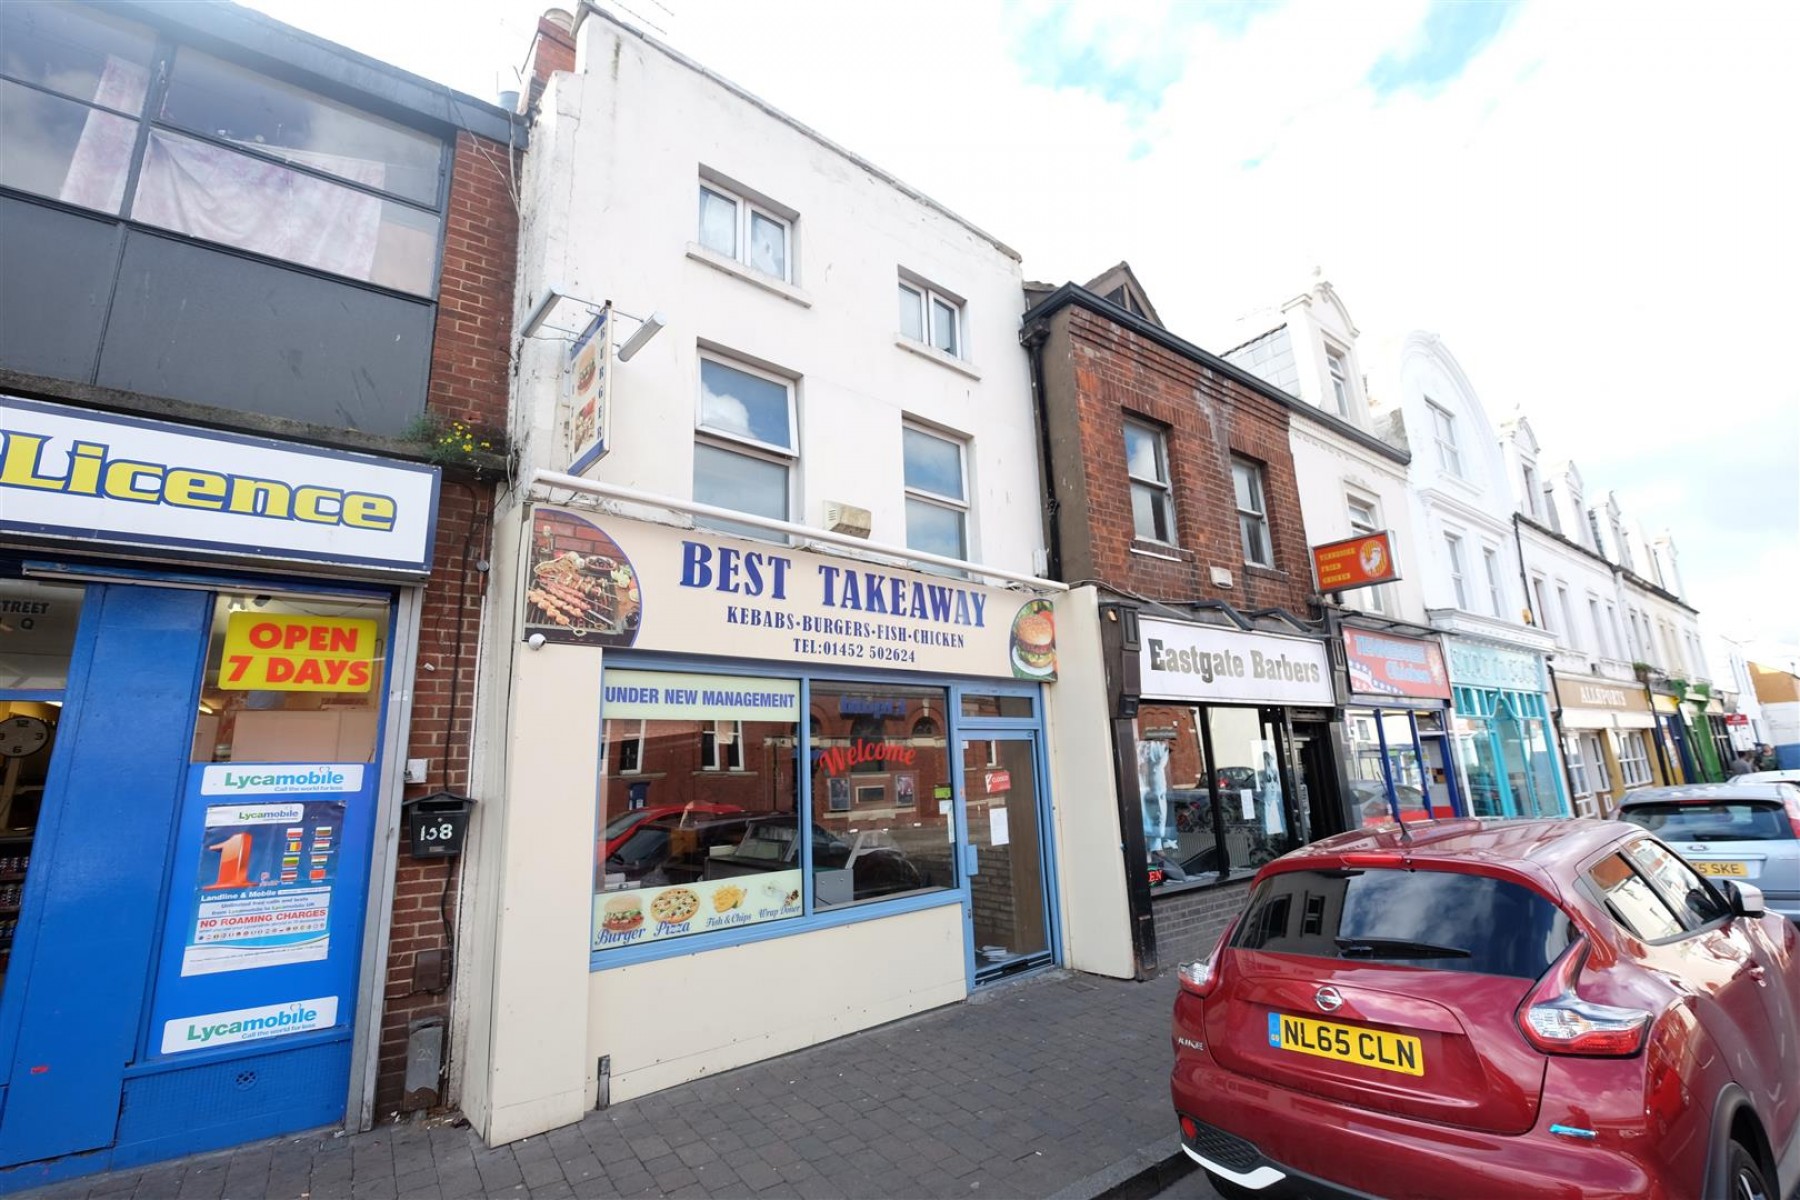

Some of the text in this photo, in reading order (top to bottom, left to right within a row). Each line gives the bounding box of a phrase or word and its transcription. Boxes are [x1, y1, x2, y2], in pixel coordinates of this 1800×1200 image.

[0, 430, 397, 532] Licence
[680, 540, 987, 628] BEST TAKEAWAY
[0, 600, 49, 614] TREET
[249, 622, 358, 652] OPEN
[793, 638, 915, 662] TEL:01452 502624
[1148, 638, 1320, 683] Eastgate Barbers
[228, 655, 369, 686] 7 DAYS
[605, 686, 795, 709] UNDER NEW MANAGEMENT
[819, 738, 916, 777] Welcome
[224, 770, 344, 789] Lycamobile
[238, 809, 298, 820] Lycamobile
[1711, 863, 1741, 874] SKE
[200, 920, 218, 928] NO
[220, 915, 273, 926] ROAMING
[276, 909, 326, 920] CHARGES
[653, 920, 691, 937] Pizza
[595, 926, 647, 945] Burger
[187, 1008, 317, 1041] Lycamobile
[1284, 1020, 1416, 1069] NL65 CLN
